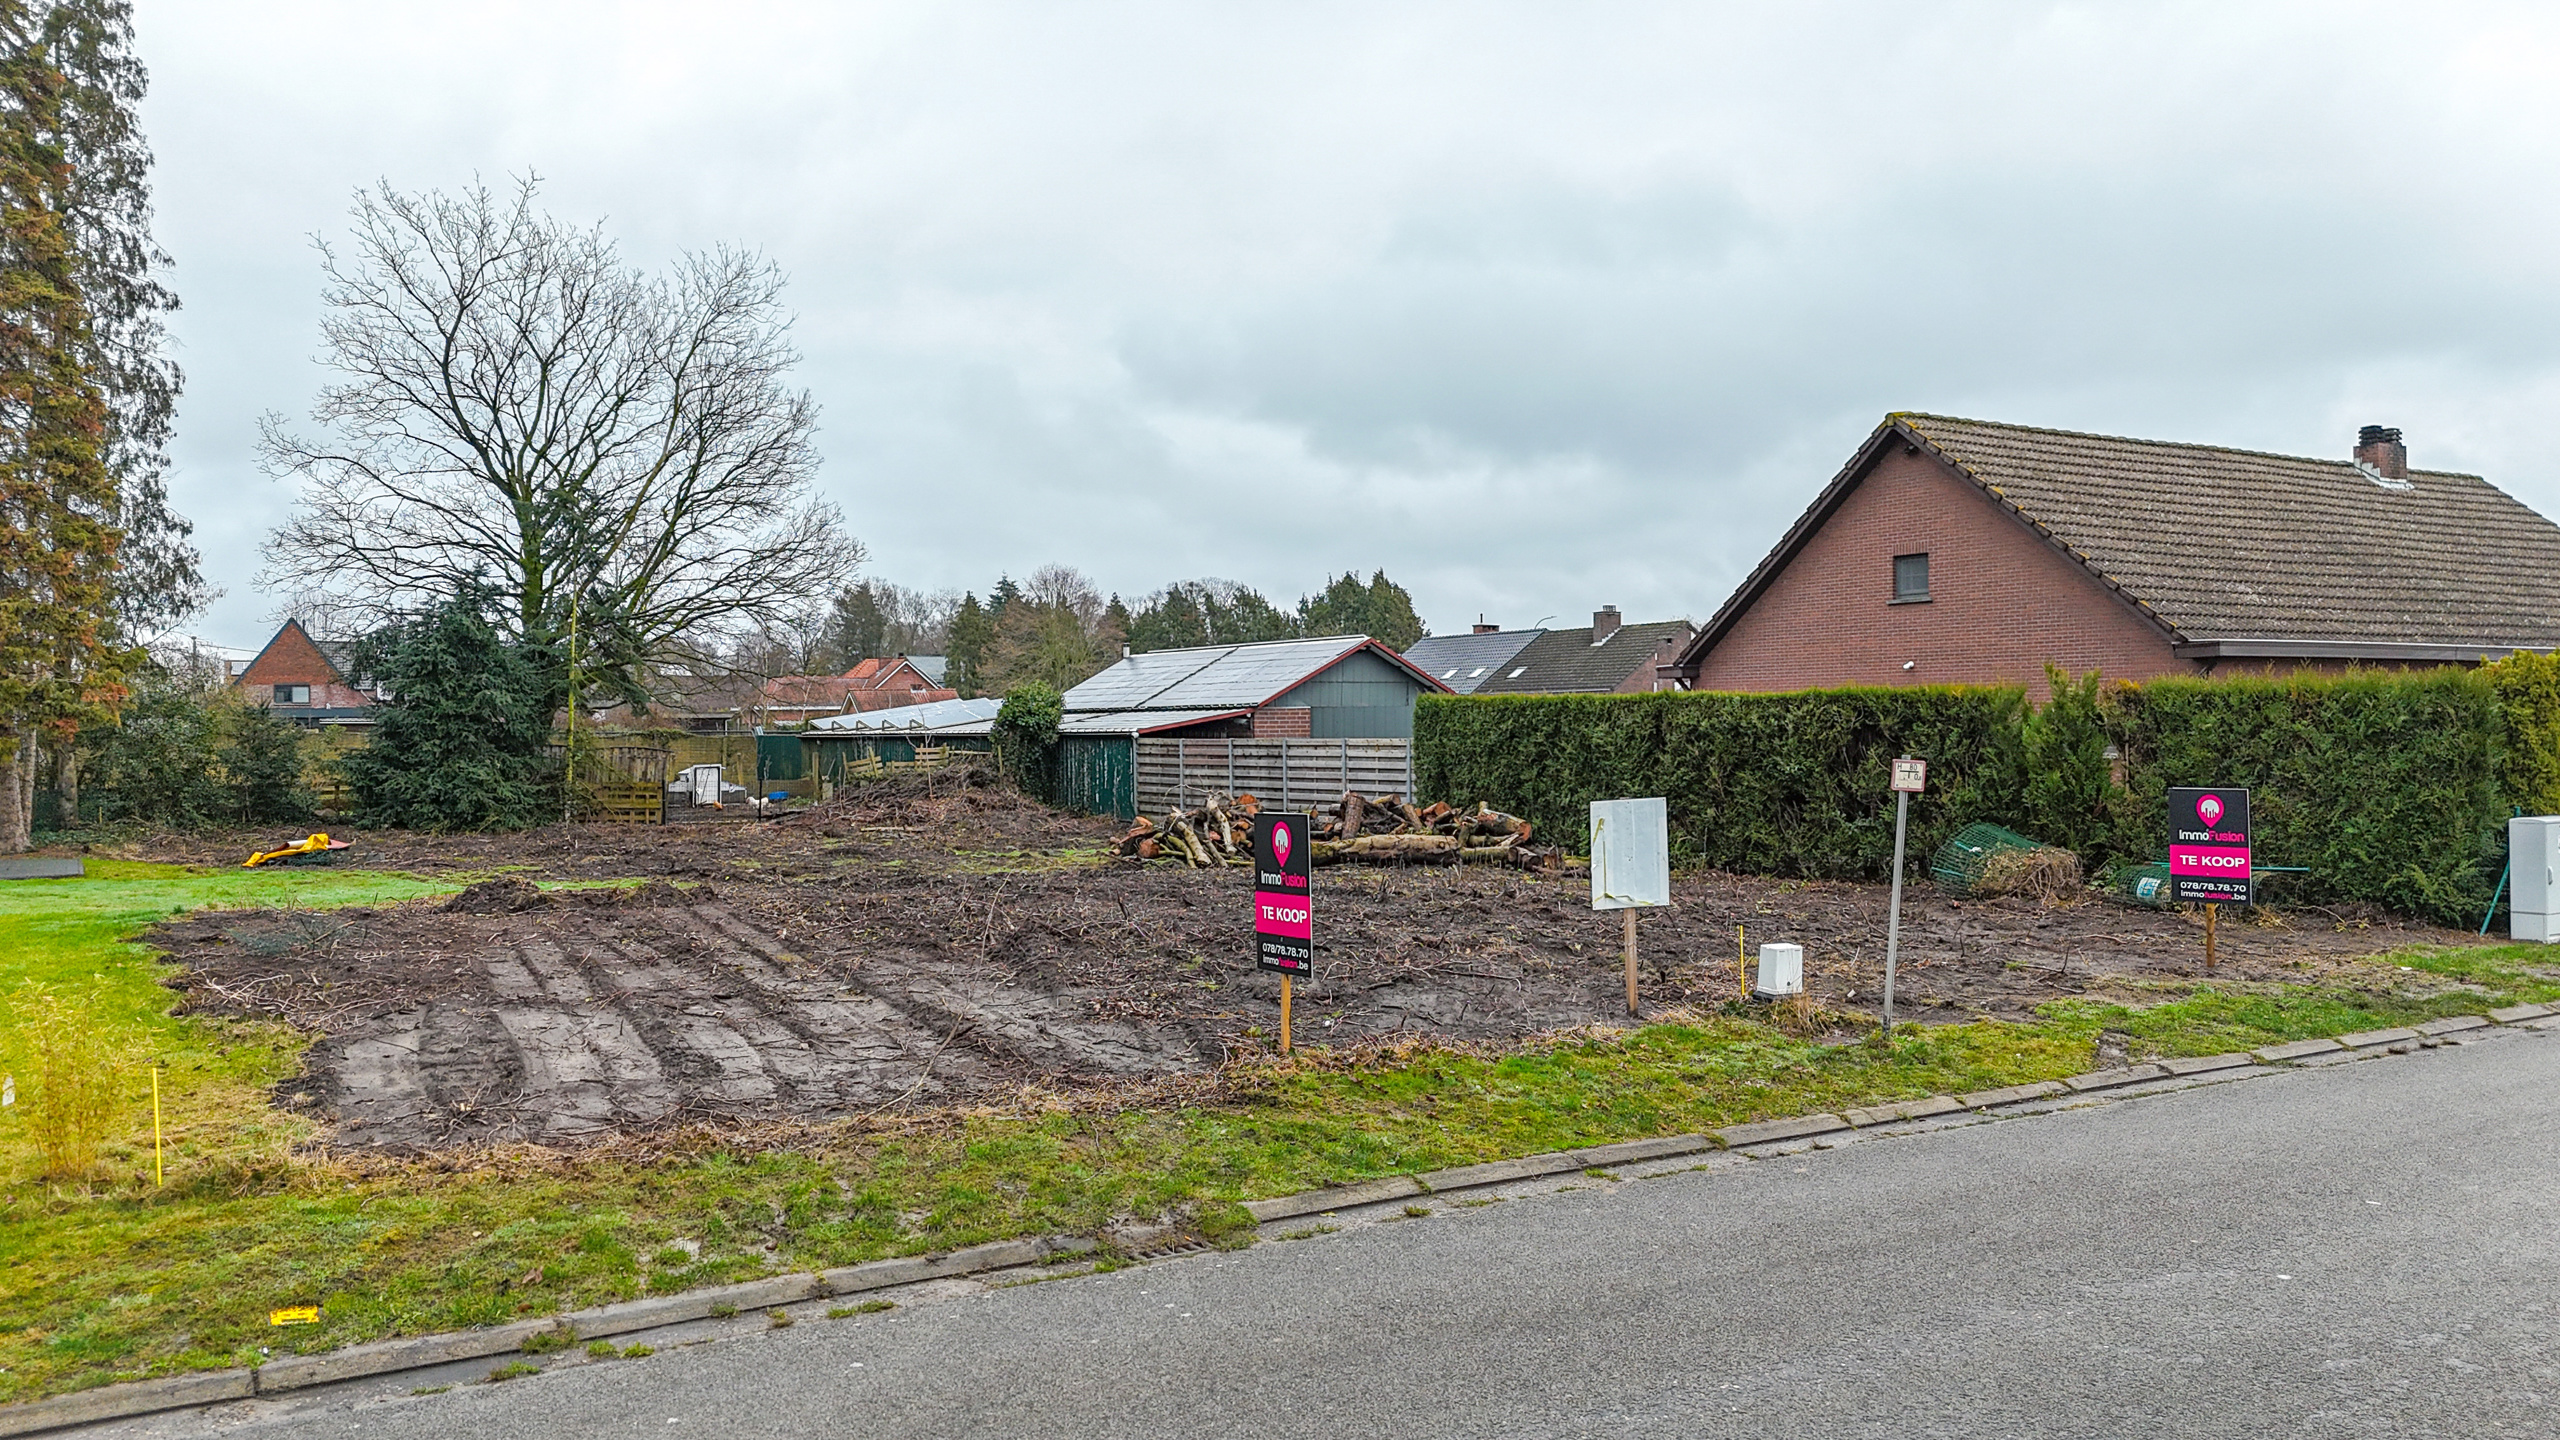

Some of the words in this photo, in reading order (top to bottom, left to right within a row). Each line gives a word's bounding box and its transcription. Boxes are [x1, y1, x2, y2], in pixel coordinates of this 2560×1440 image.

[1909, 763, 1918, 771] 80
[2179, 829, 2245, 842] ImmoFusion
[2180, 855, 2198, 866] TE
[2202, 856, 2245, 868] KOOP
[1261, 870, 1307, 888] ImmoFusion
[2180, 881, 2246, 892] 078/78.78.70
[1262, 906, 1274, 920] TE
[1276, 907, 1307, 923] KOOP
[1262, 943, 1308, 958] 078/78.78.70
